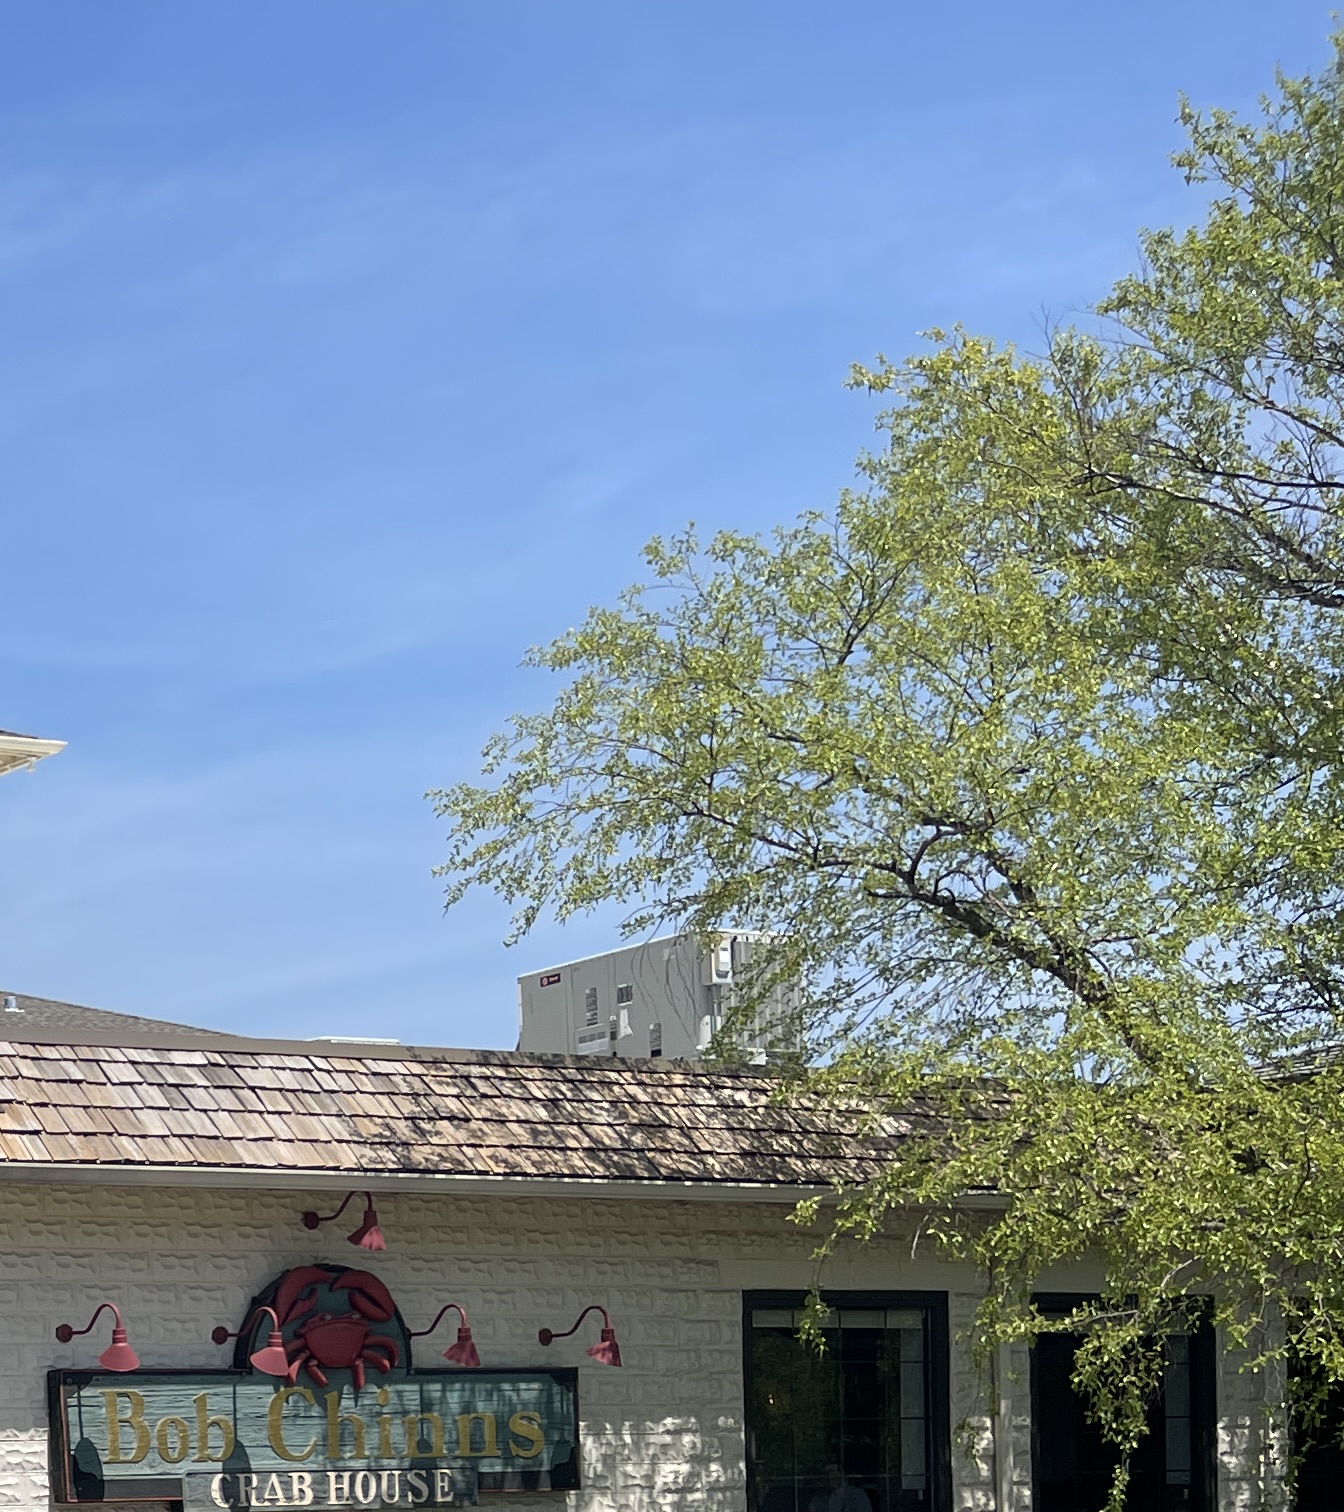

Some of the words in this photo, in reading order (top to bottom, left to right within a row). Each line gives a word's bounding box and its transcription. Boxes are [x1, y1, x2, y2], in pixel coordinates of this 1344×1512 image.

[97, 1388, 235, 1464] Bob
[267, 1386, 545, 1463] Chinns
[211, 1472, 315, 1508] CRAB
[326, 1469, 454, 1505] HOUSE
